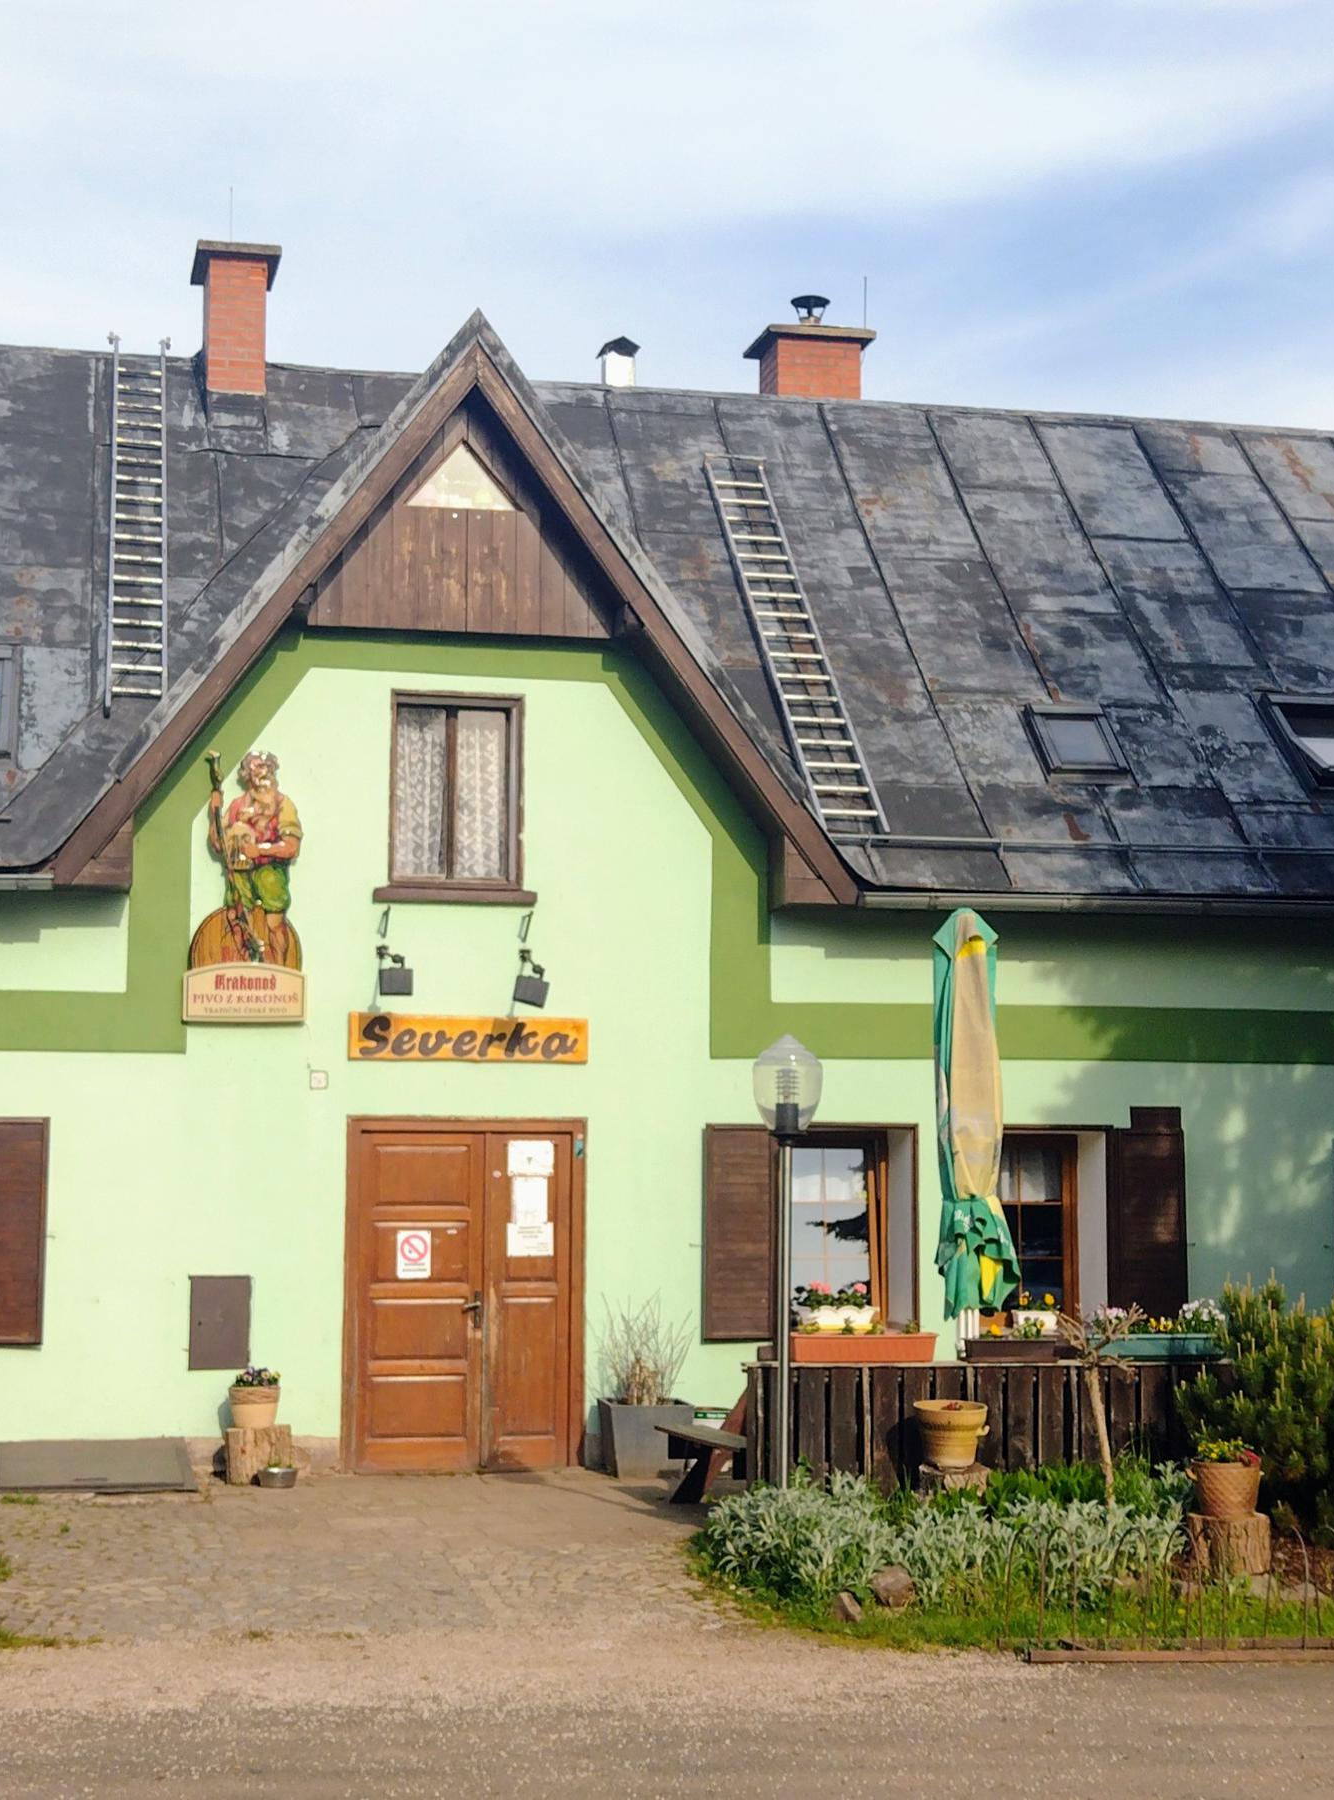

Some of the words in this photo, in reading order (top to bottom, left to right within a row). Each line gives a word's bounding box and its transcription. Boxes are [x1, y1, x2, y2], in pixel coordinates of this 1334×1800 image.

[215, 974, 275, 990] Krakonoš
[193, 994, 223, 1004] PIVO
[237, 992, 299, 1004] KRKONOŠ
[359, 1015, 579, 1060] Severka
